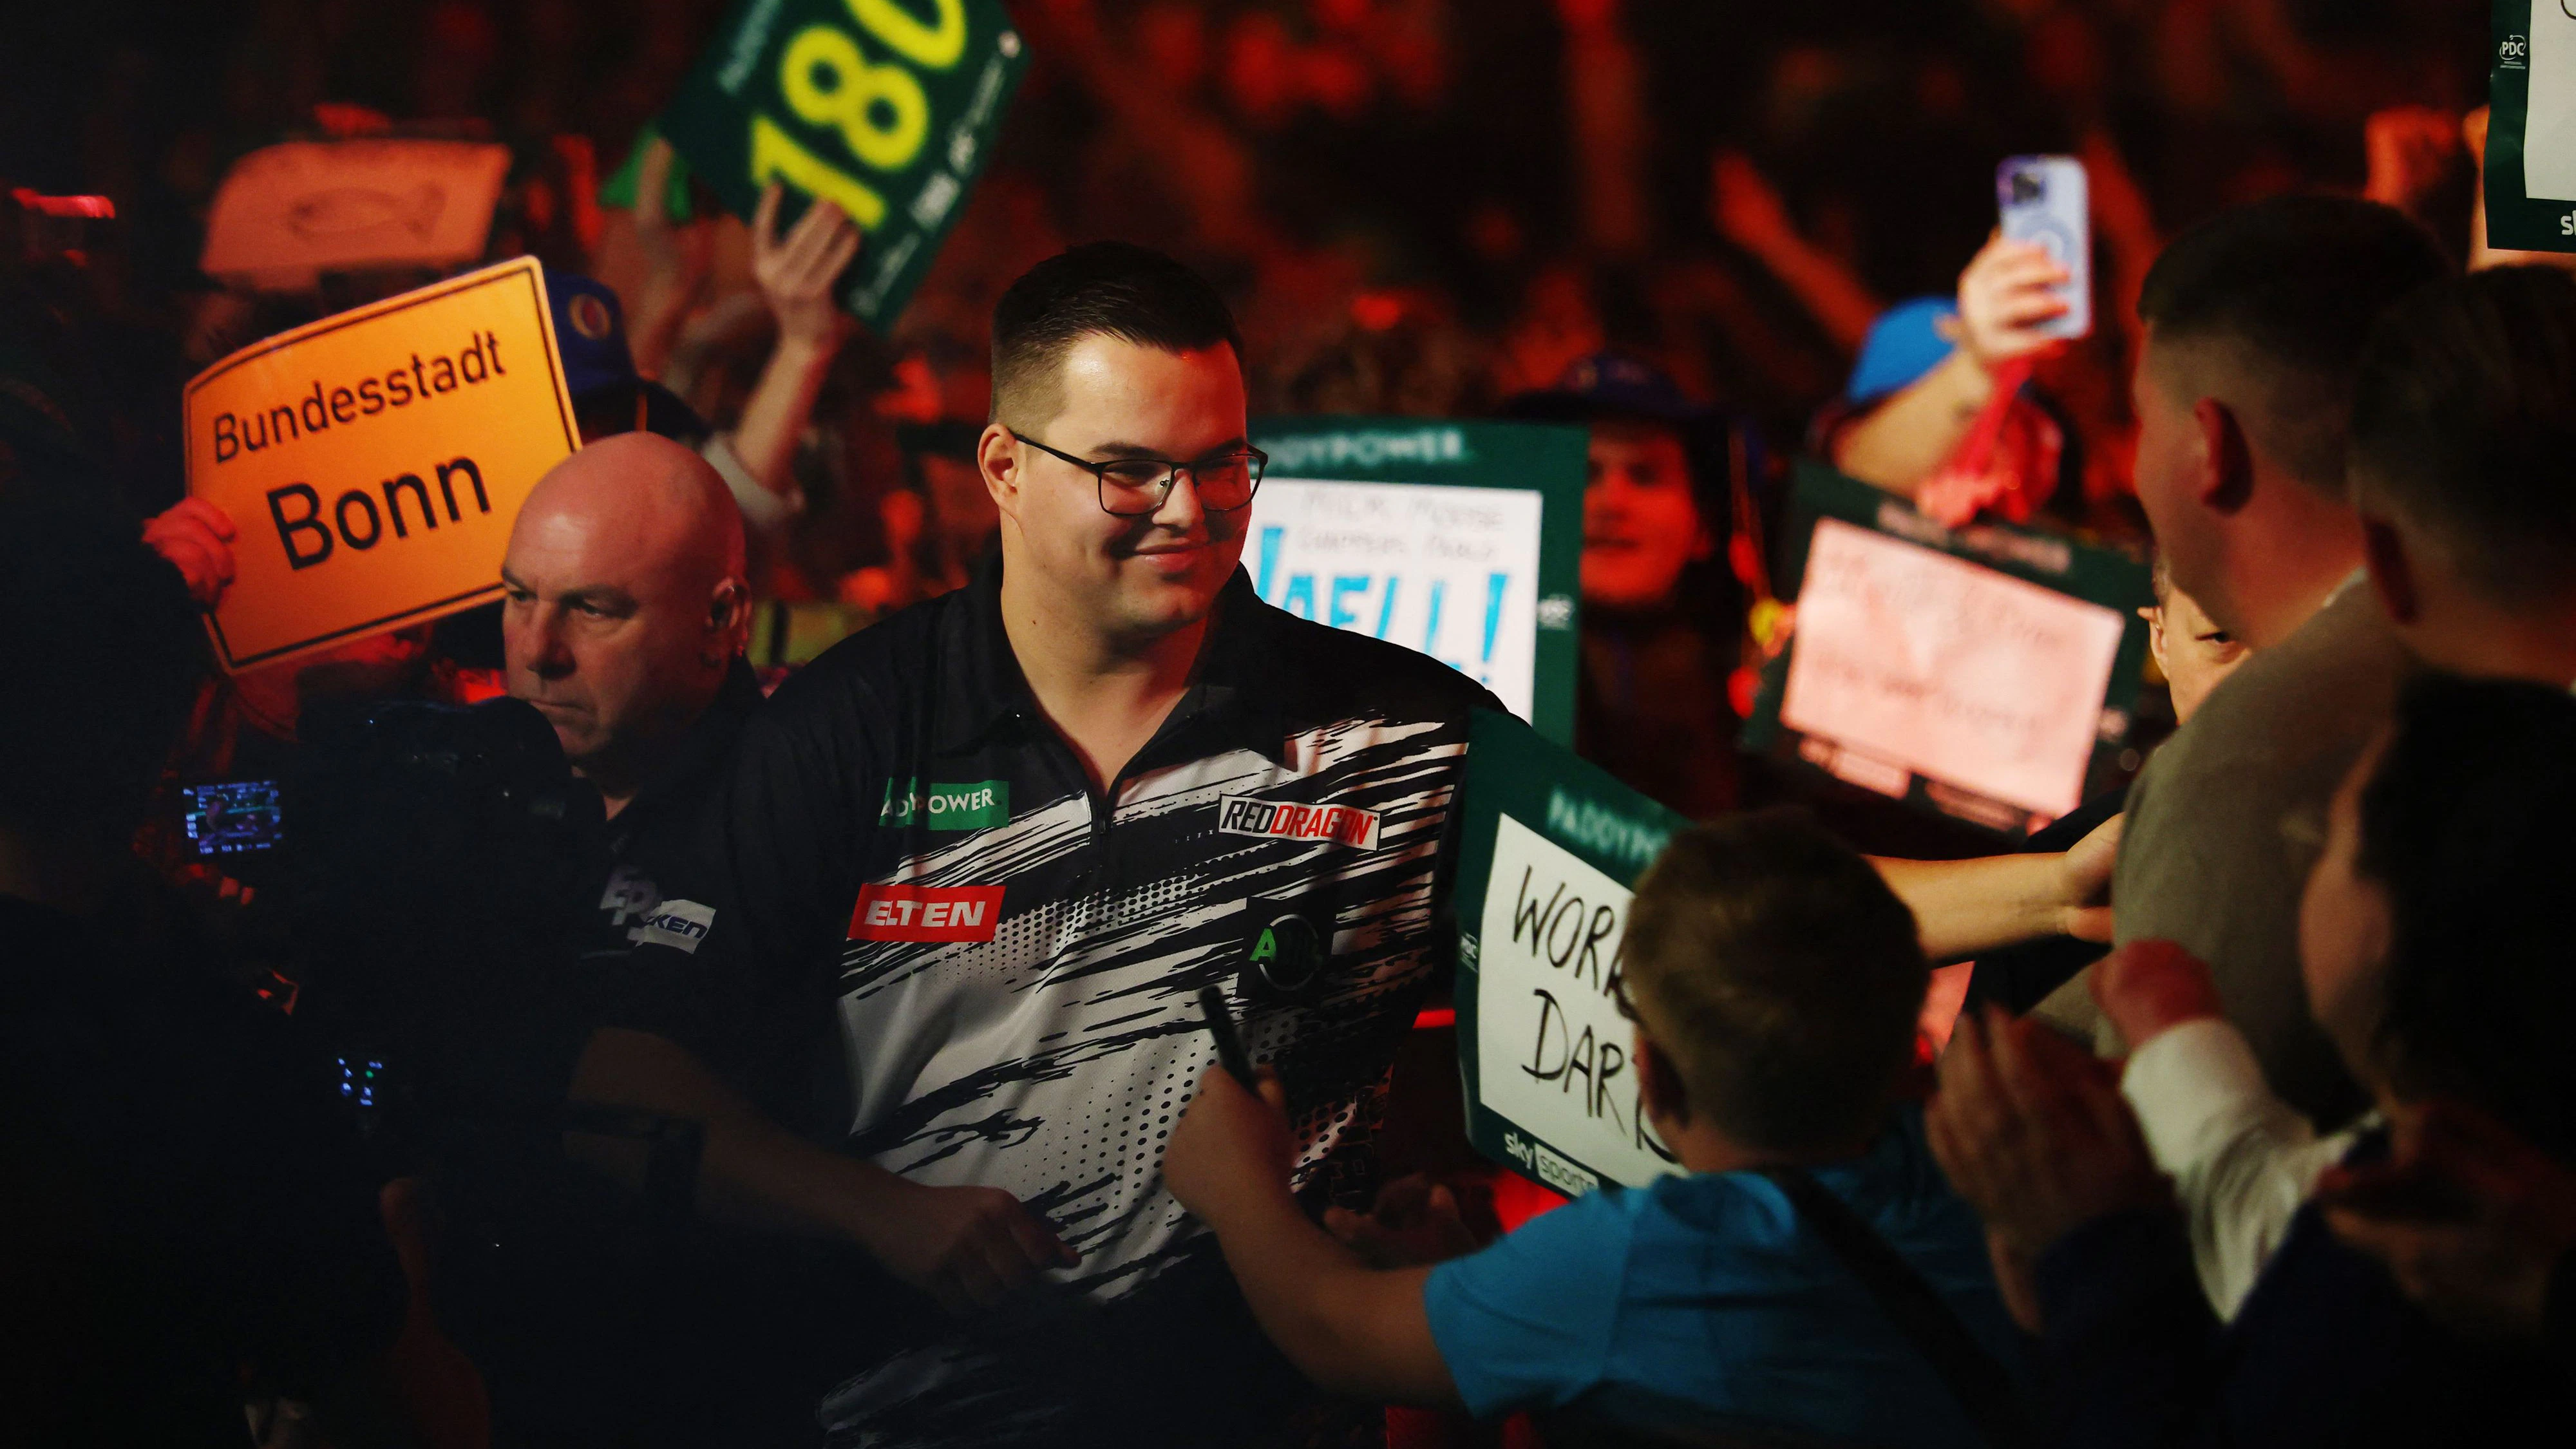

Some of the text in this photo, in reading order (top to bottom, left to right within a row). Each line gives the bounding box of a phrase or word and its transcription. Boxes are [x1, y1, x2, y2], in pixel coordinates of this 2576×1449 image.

[2501, 41, 2524, 56] PDC
[214, 330, 506, 464] Bundesstadt
[266, 455, 491, 571] Bonn
[1221, 800, 1374, 845] REDDRAGON
[864, 900, 986, 927] ELTEN
[1504, 1132, 1533, 1170] sky
